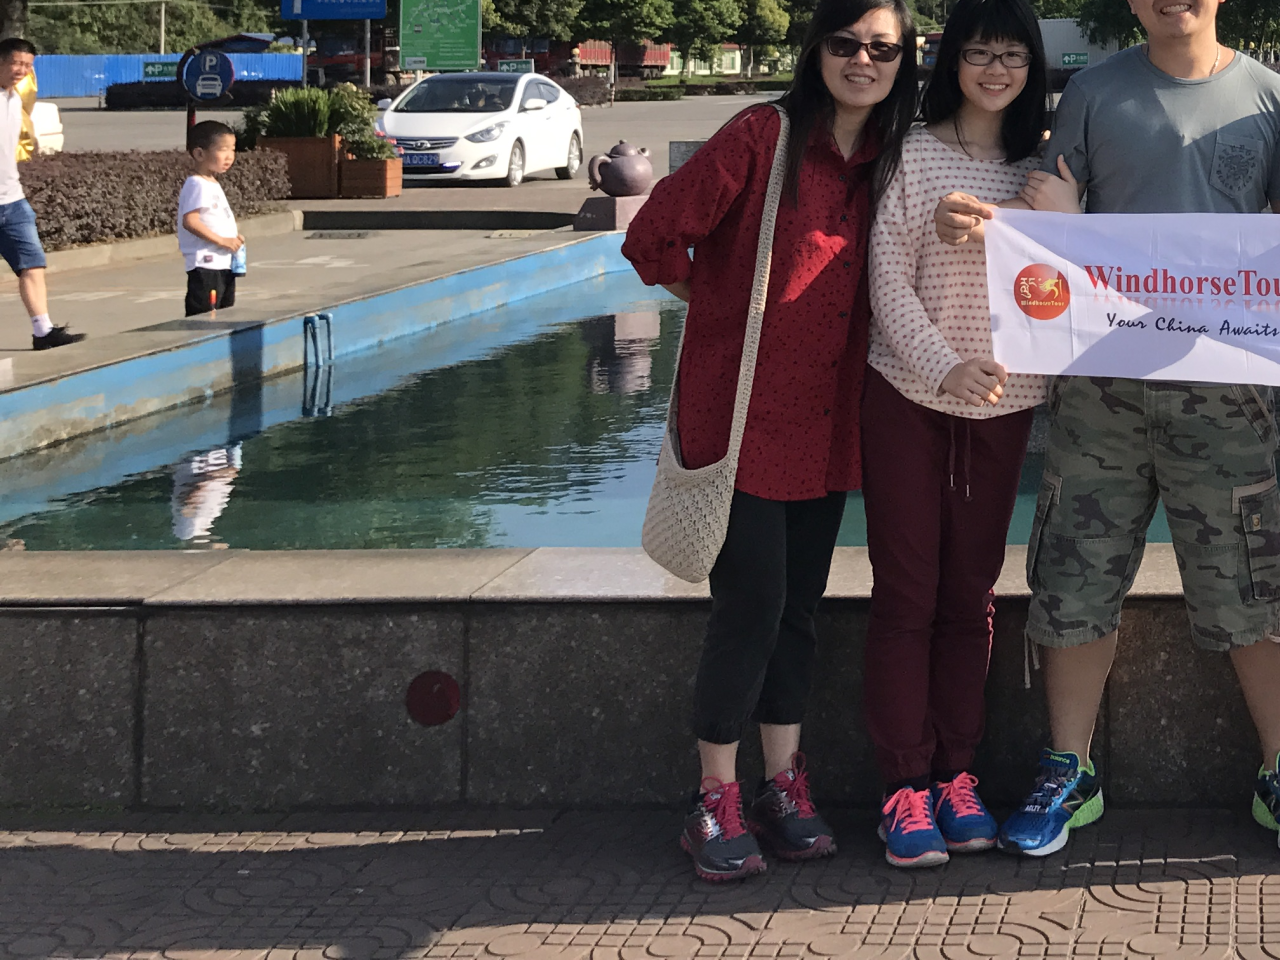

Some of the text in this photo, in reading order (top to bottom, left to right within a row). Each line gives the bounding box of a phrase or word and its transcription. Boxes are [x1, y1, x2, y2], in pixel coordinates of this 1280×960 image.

[205, 55, 217, 71] P
[1106, 312, 1148, 330] Your
[1155, 316, 1210, 334] China
